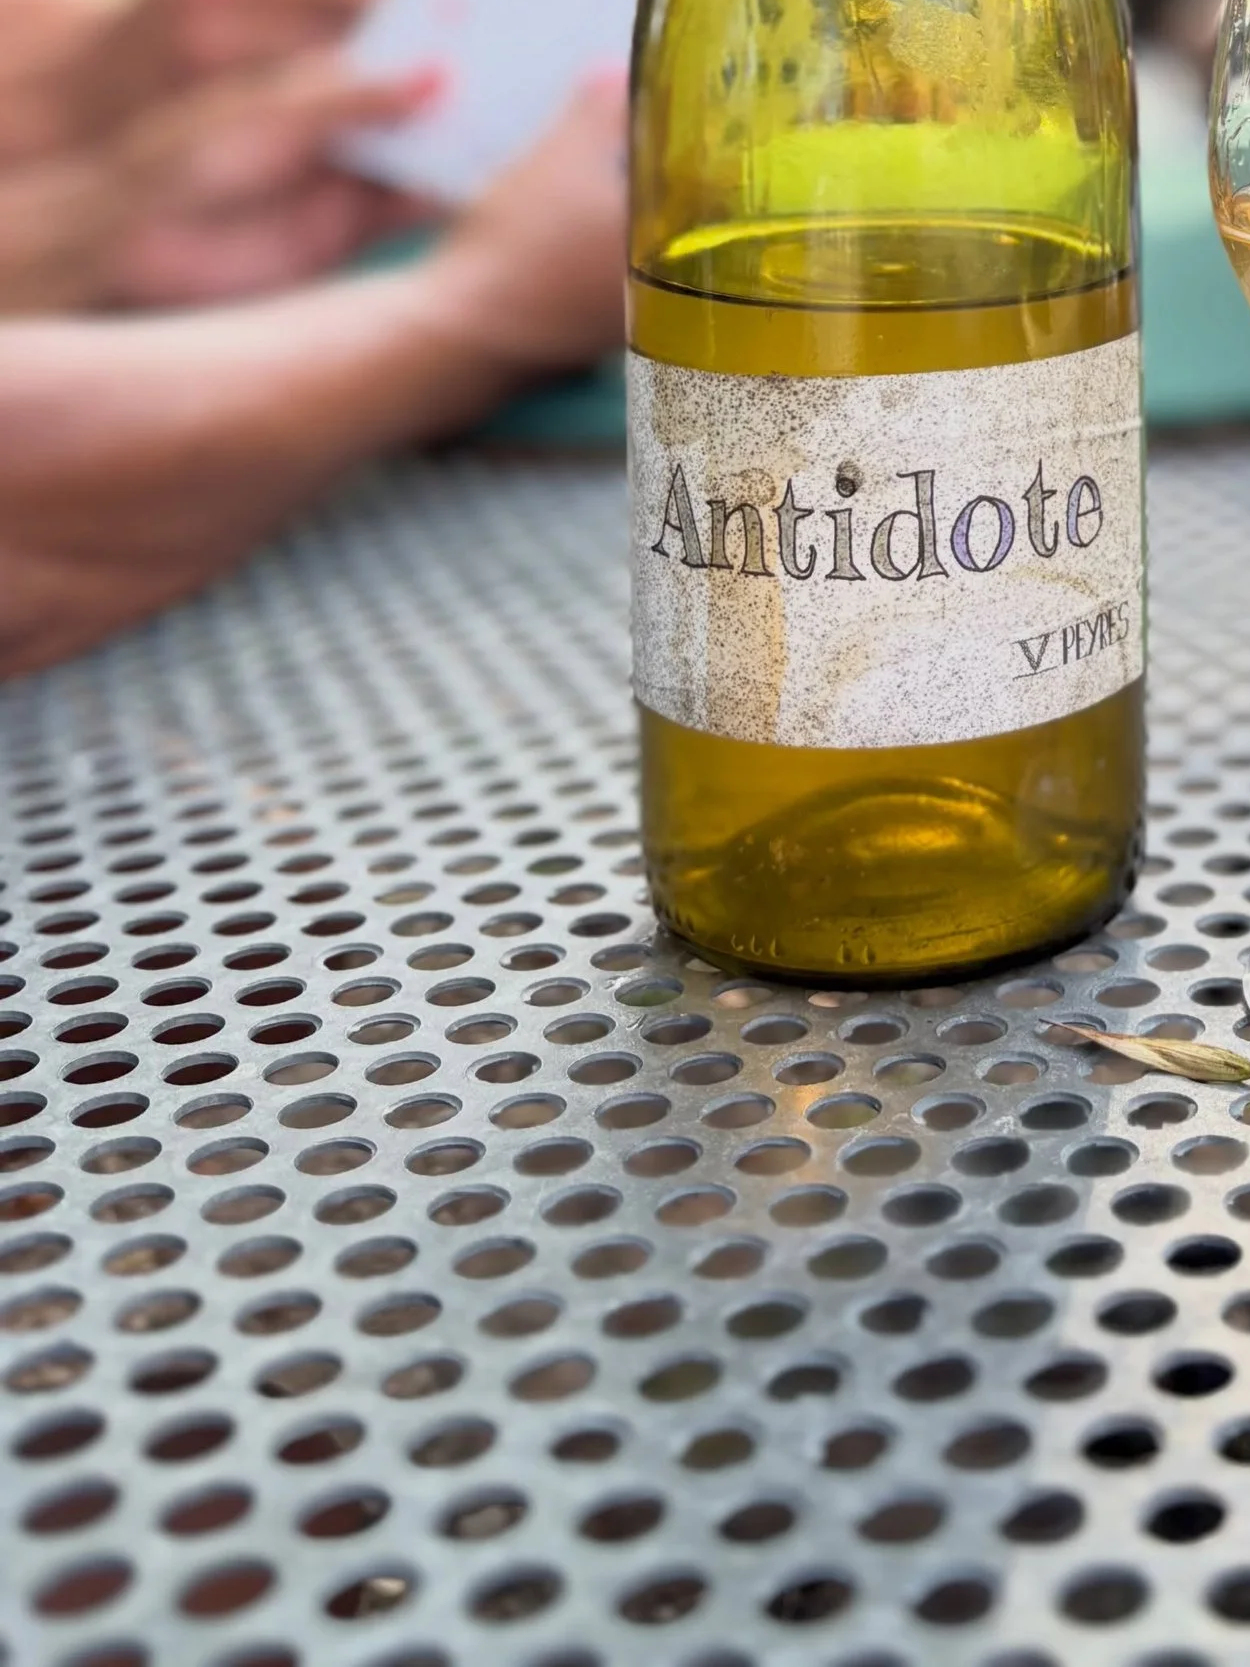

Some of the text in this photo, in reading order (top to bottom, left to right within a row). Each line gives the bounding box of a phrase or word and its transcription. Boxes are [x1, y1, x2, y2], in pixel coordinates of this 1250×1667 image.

[651, 458, 1104, 581] Antidote
[1010, 600, 1130, 681] V PEYRES
